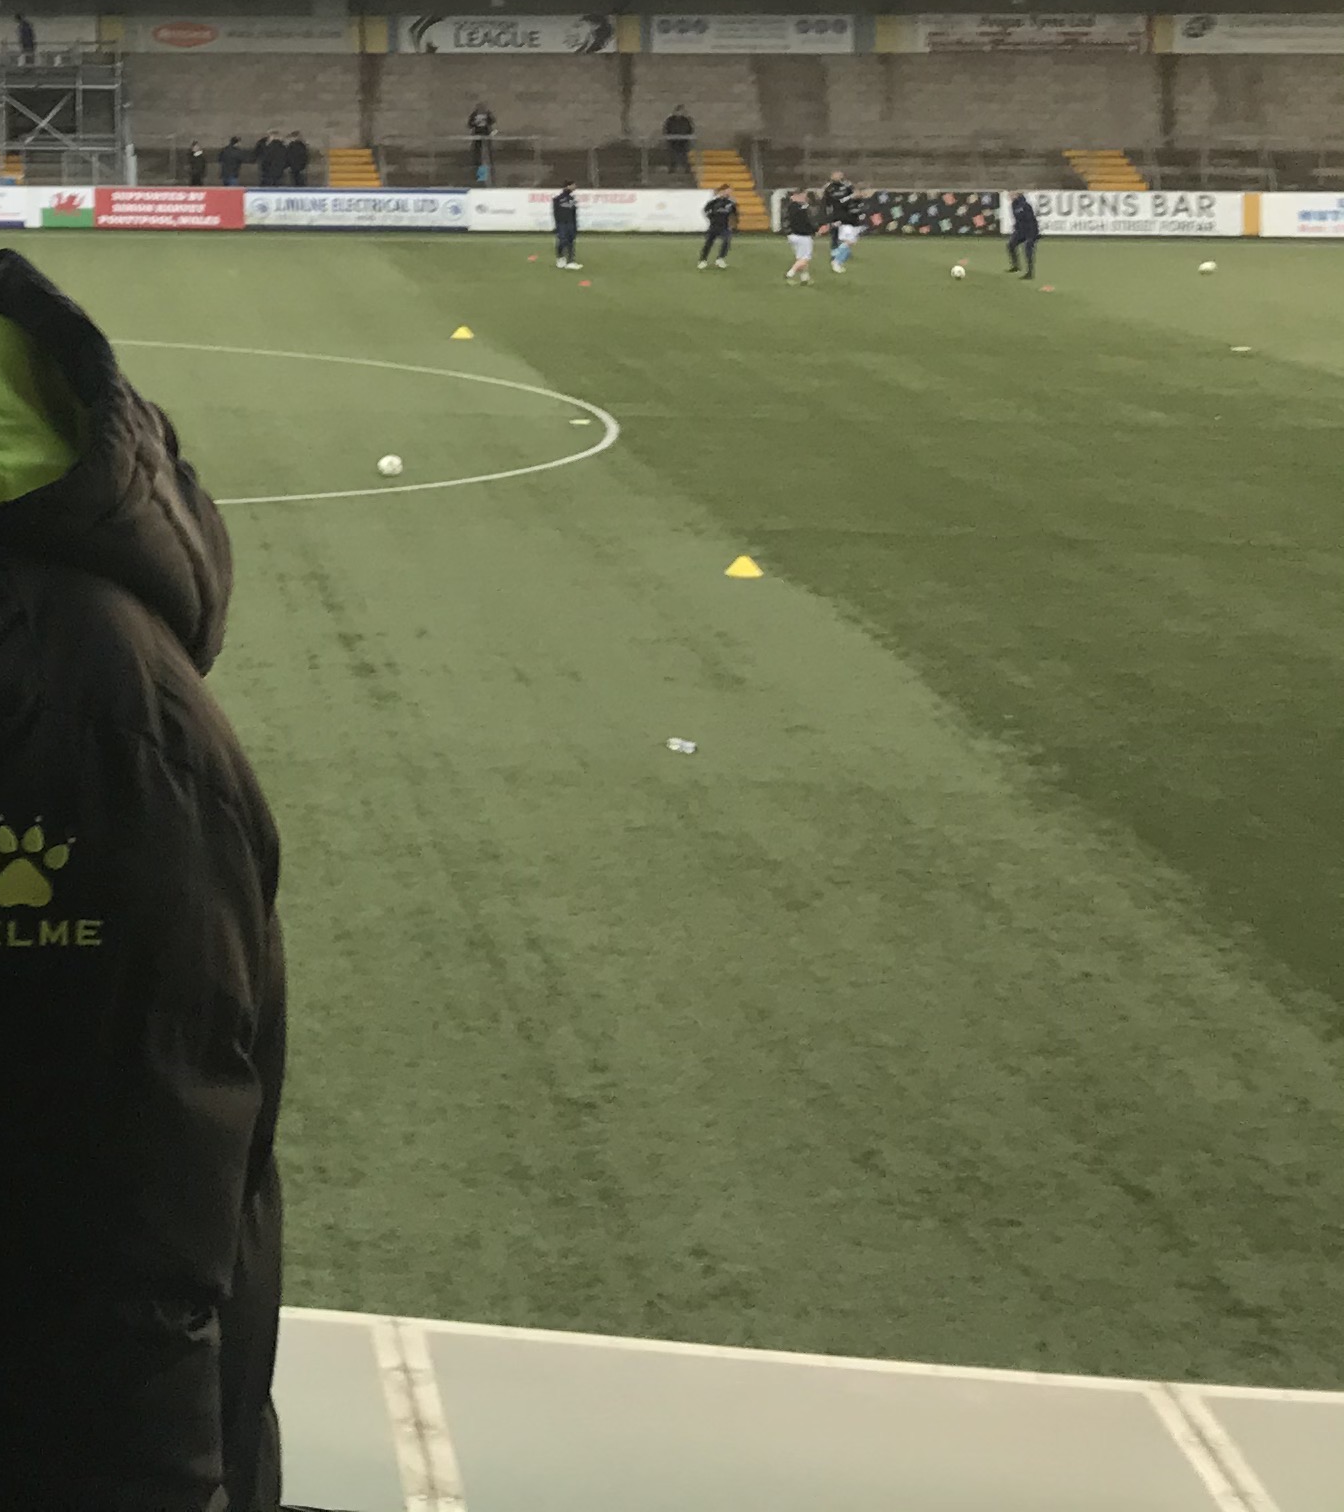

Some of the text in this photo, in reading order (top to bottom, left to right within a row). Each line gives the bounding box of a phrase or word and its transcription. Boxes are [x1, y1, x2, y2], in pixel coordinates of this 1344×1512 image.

[453, 22, 542, 49] LEAGUE
[110, 191, 207, 202] SUPPORTED BY
[331, 197, 410, 213] ELECTRICAL
[413, 198, 440, 213] LTD
[1035, 193, 1216, 218] BURNS BAR
[1070, 219, 1105, 232] HIGH
[1110, 219, 1157, 232] STREET
